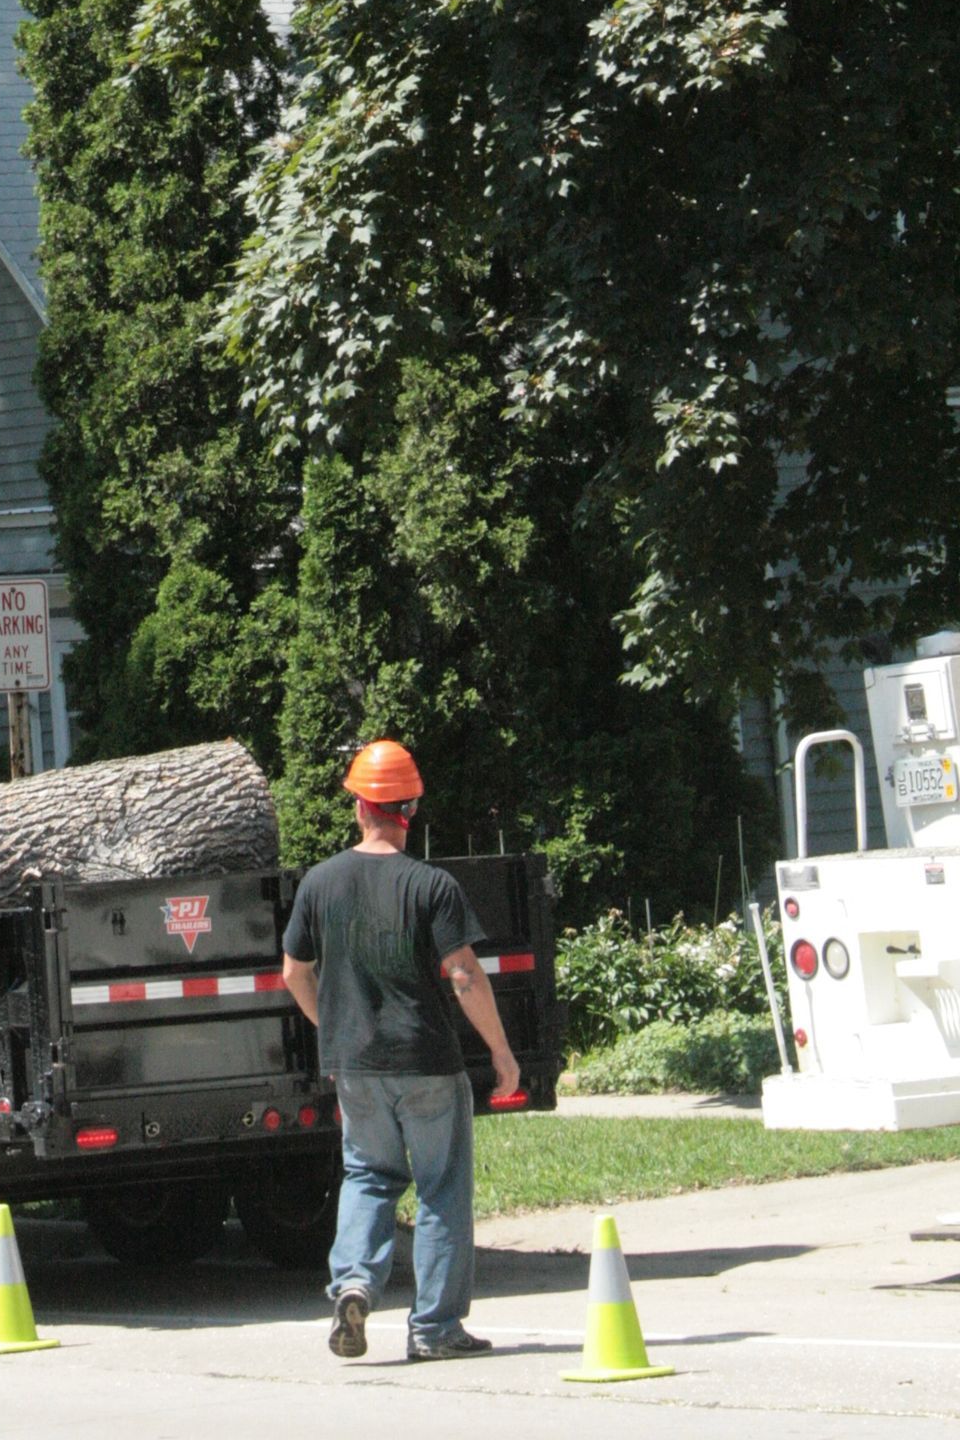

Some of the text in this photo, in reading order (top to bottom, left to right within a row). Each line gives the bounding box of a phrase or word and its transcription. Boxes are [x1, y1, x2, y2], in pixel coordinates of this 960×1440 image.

[2, 591, 26, 611] NO
[3, 645, 29, 659] ANY
[2, 661, 33, 675] TIME
[909, 767, 944, 793] 10552
[178, 901, 201, 918] PJ
